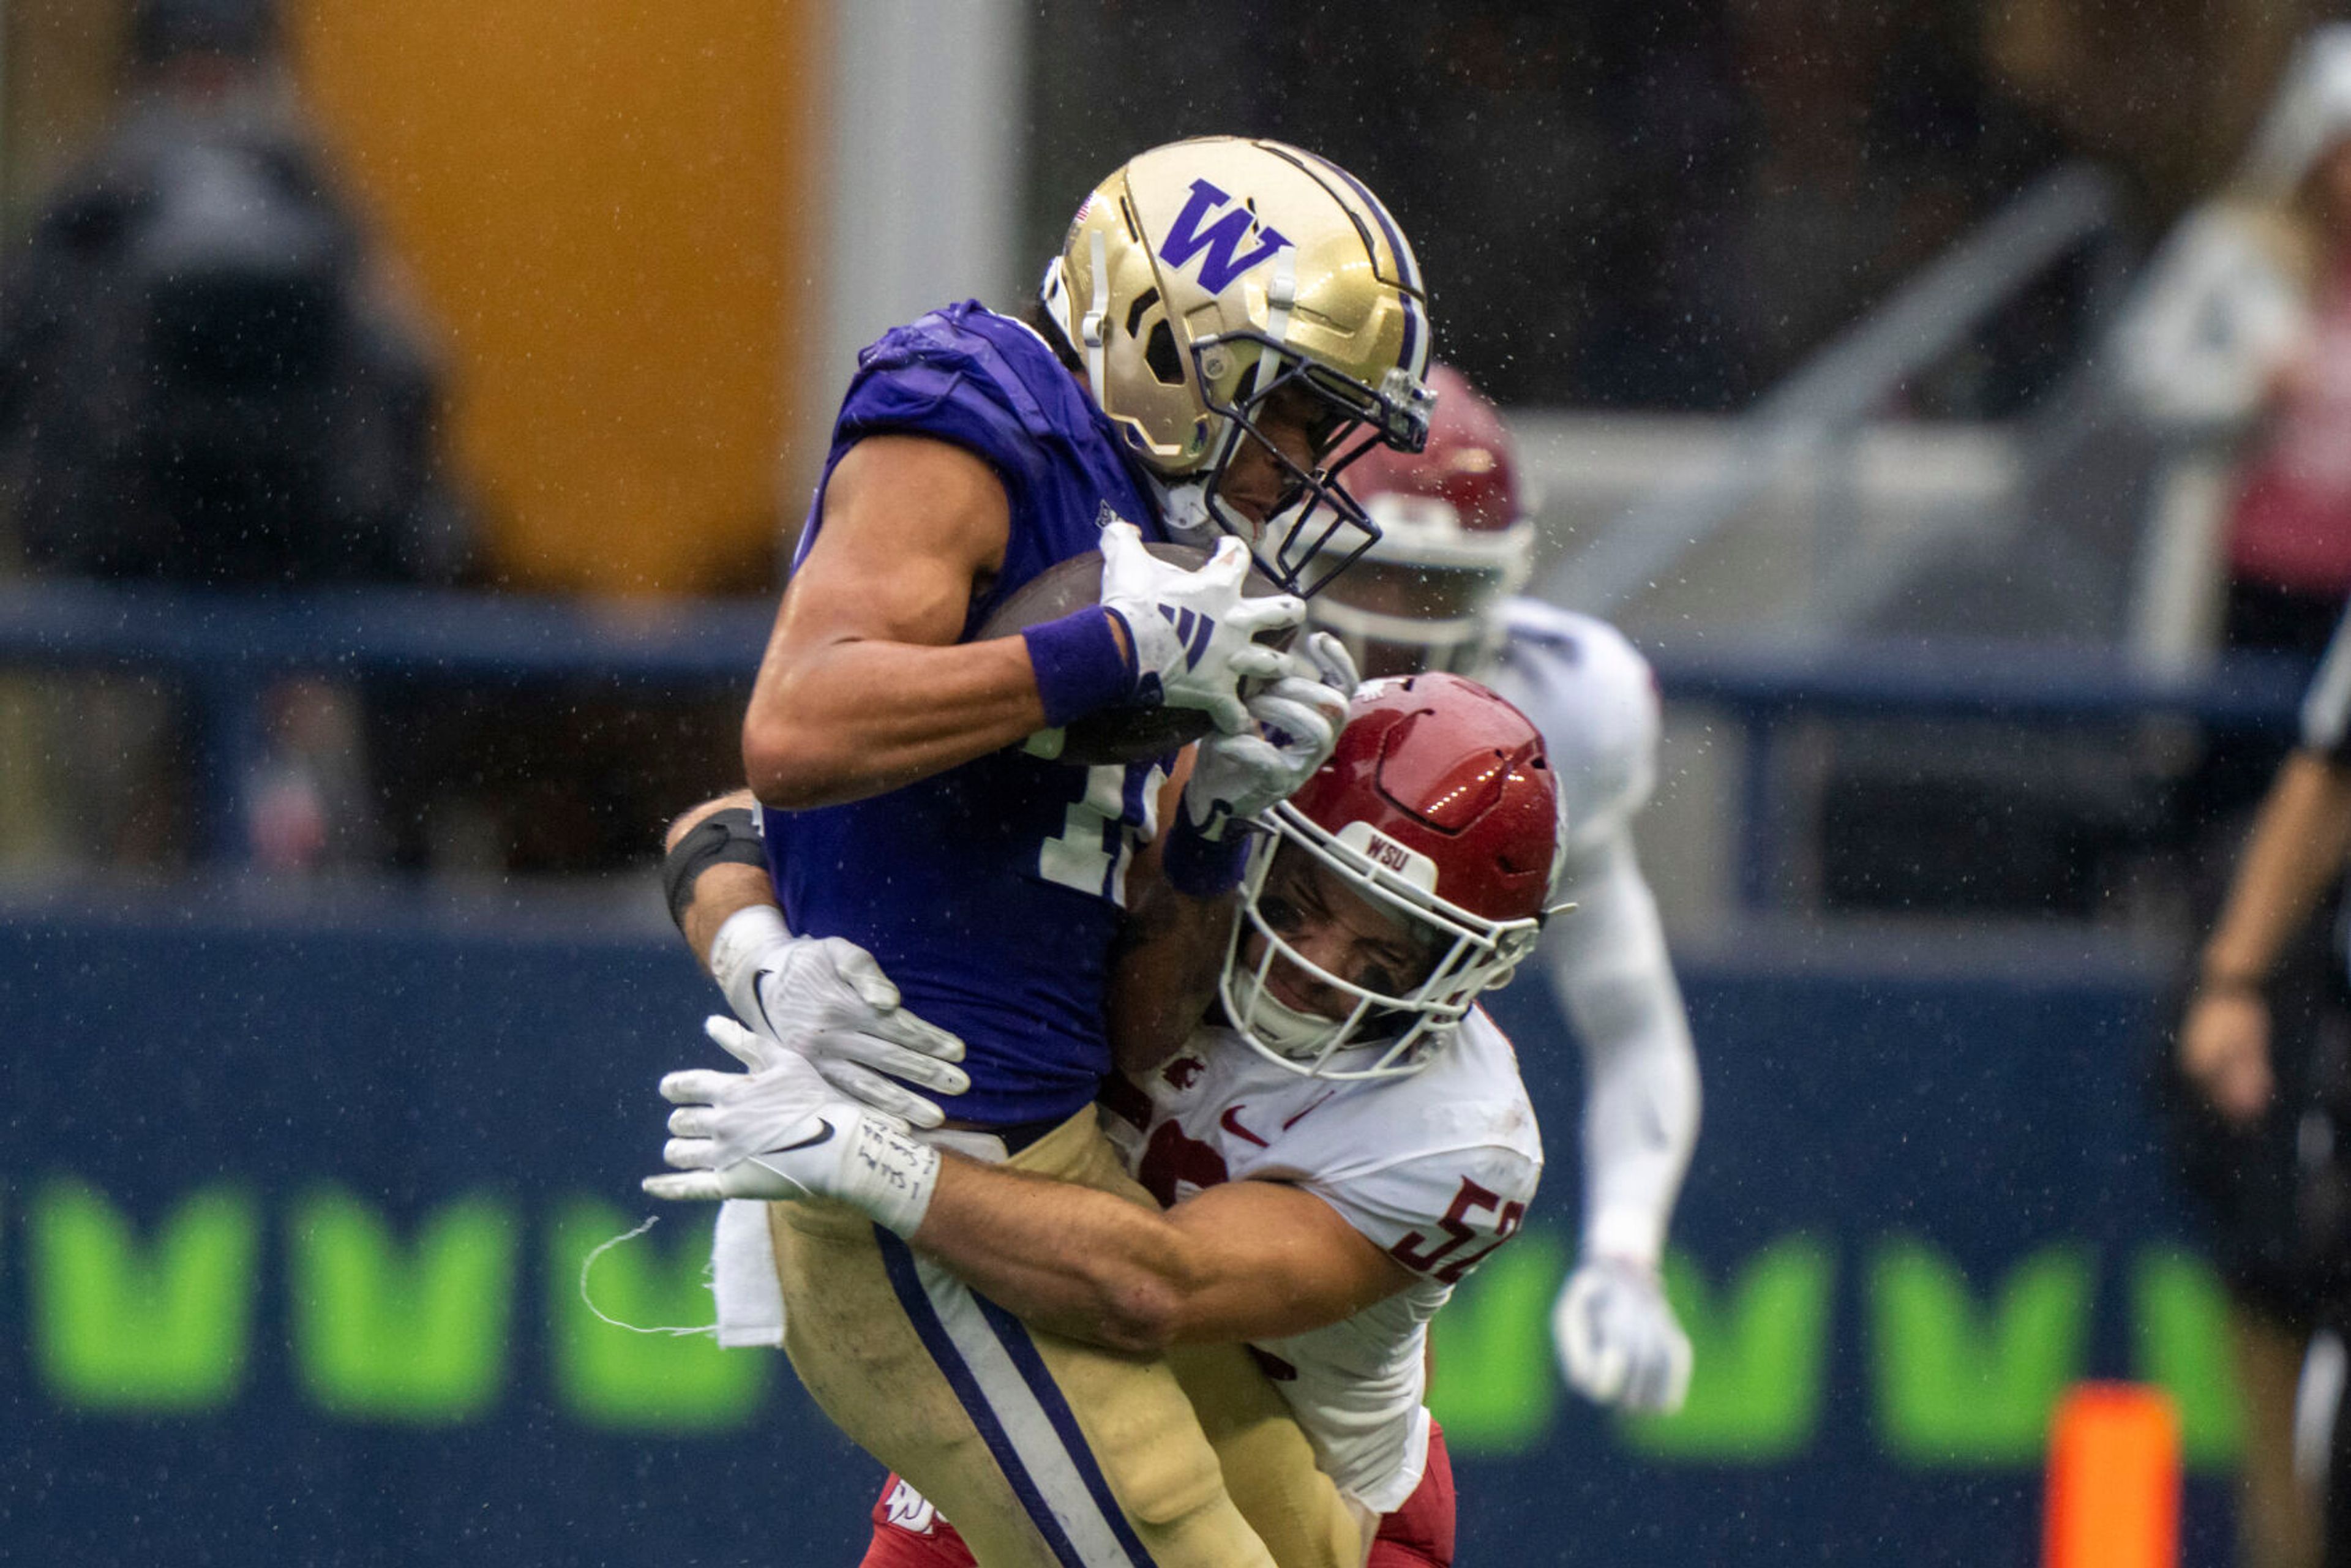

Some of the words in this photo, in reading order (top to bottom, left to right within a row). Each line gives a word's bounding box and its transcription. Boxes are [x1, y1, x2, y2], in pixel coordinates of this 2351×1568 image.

[1159, 178, 1294, 295] W
[1366, 835, 1411, 872] WSU
[1390, 1175, 1526, 1285] 52
